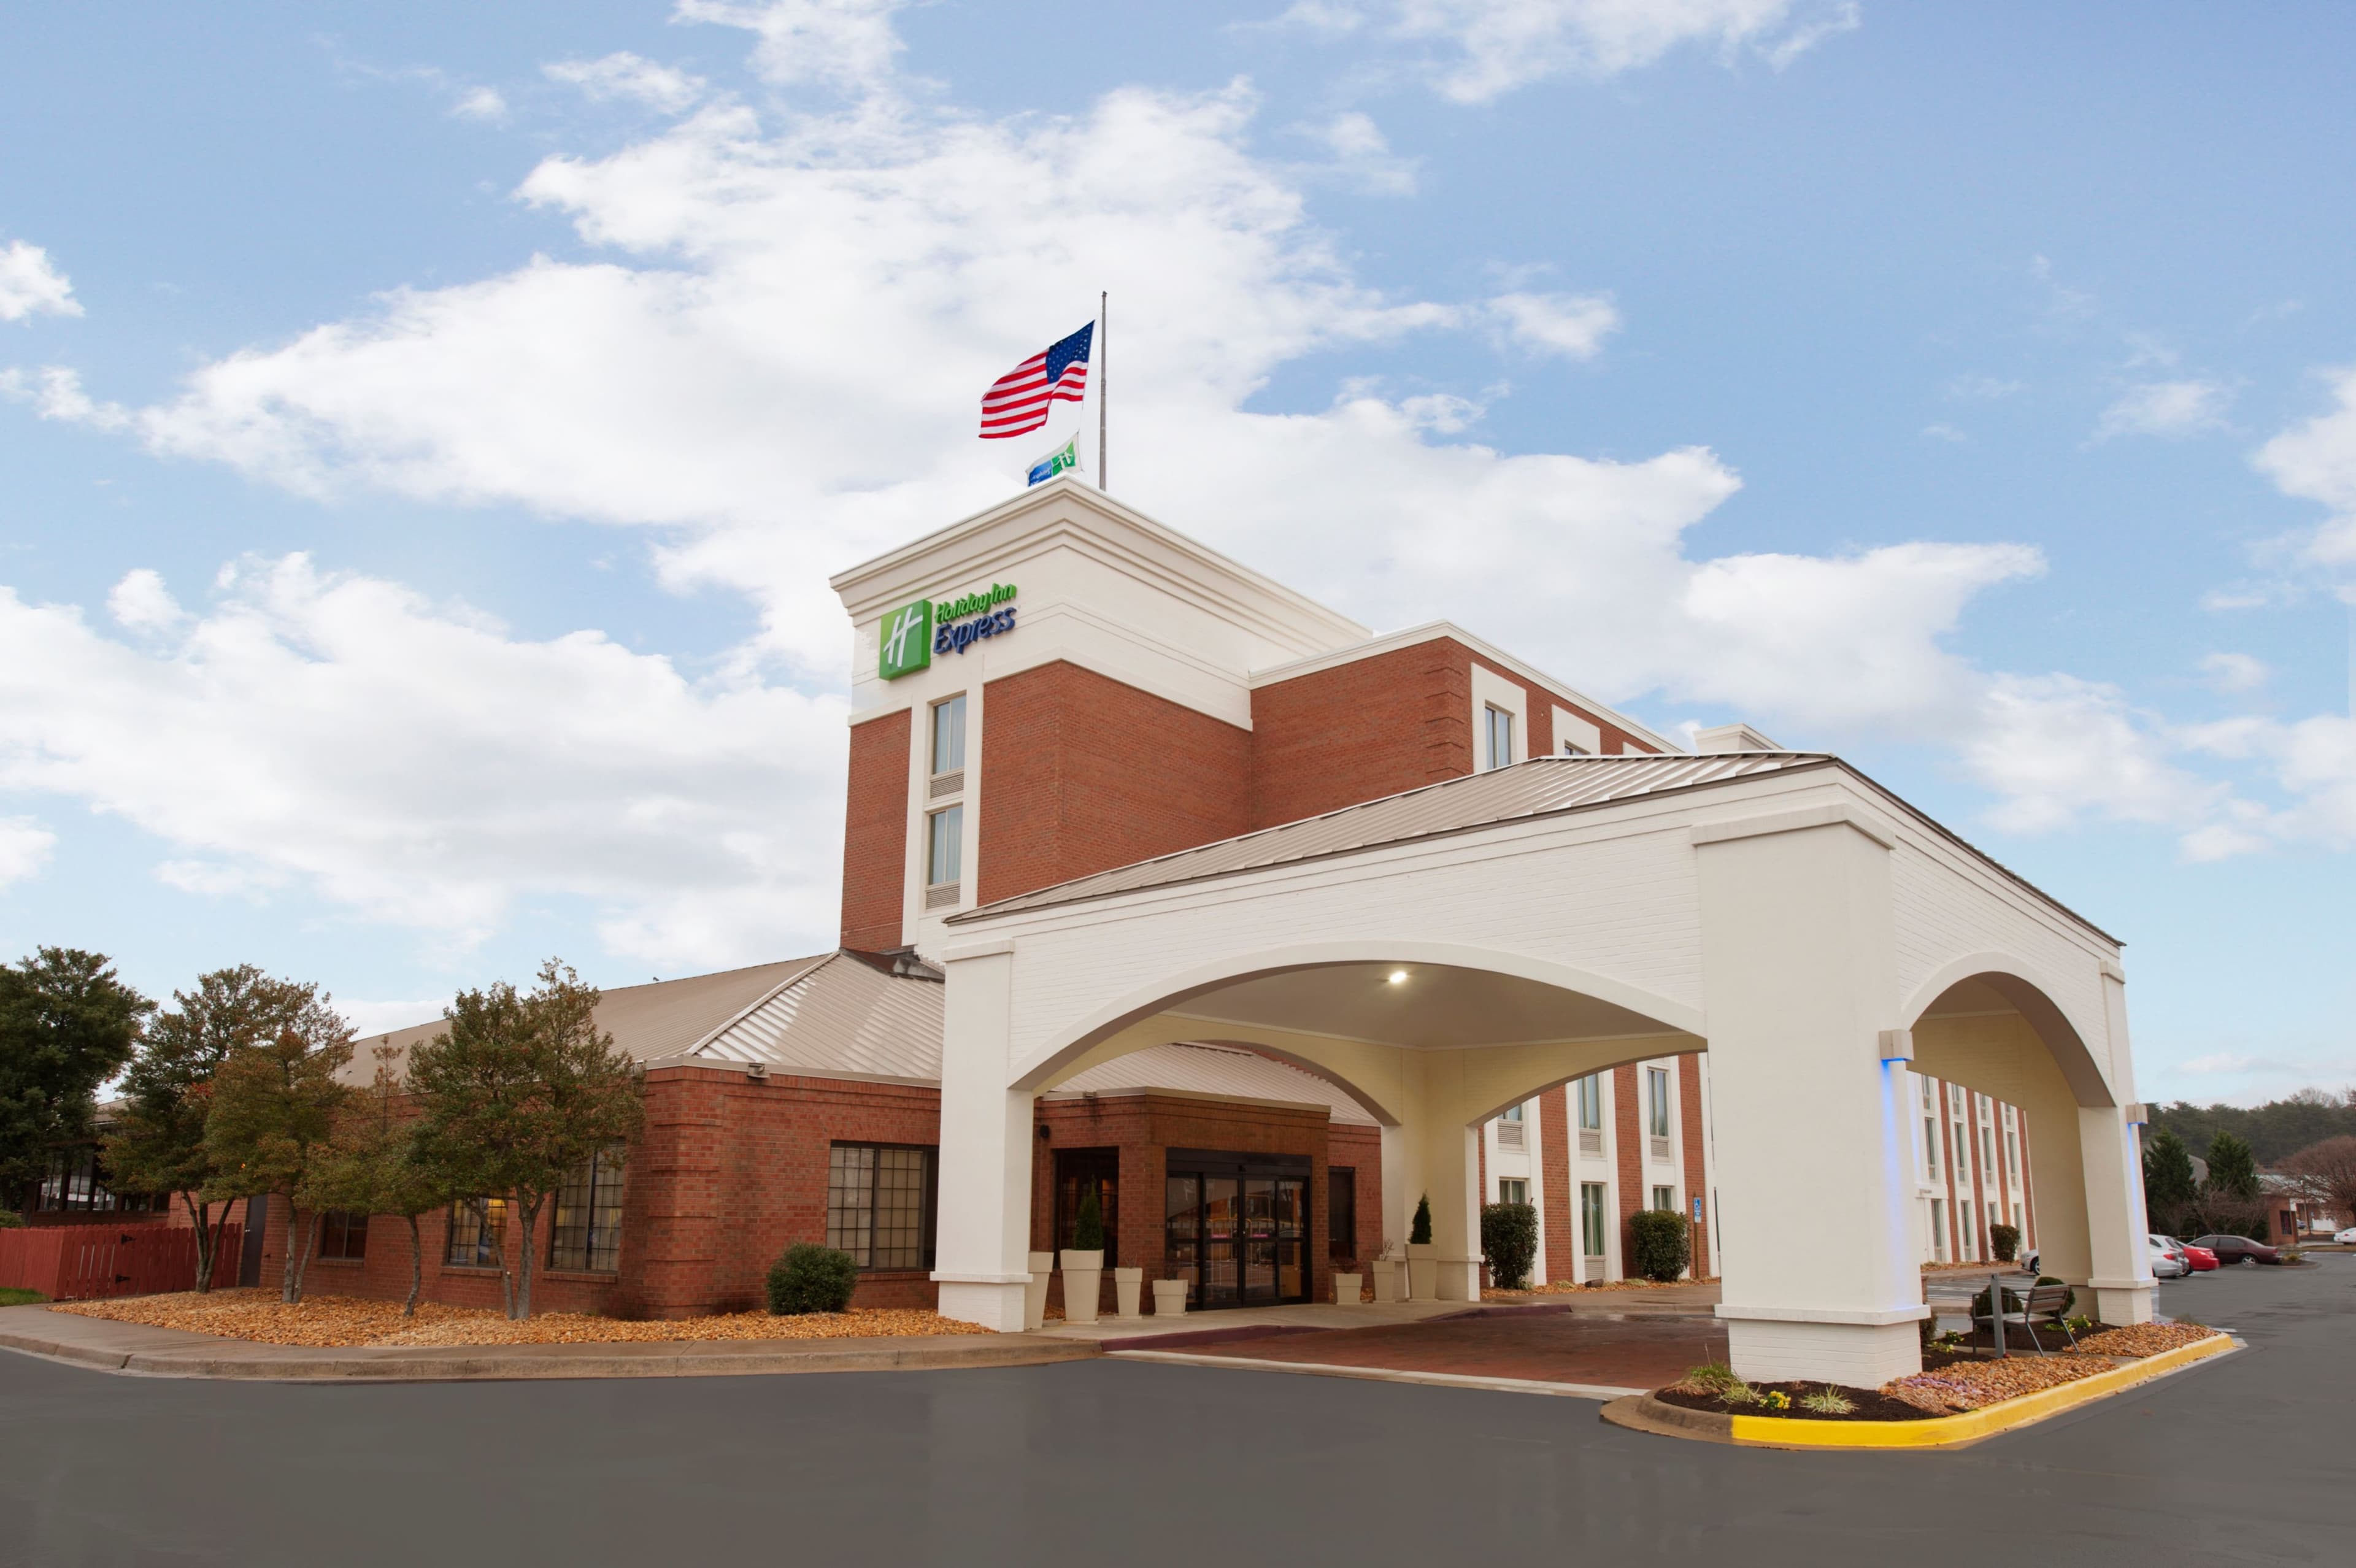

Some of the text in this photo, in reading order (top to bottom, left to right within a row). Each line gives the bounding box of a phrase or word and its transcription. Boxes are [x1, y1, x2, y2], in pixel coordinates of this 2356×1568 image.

[935, 583, 1017, 624] Holiday Inn
[933, 607, 1017, 655] Express
